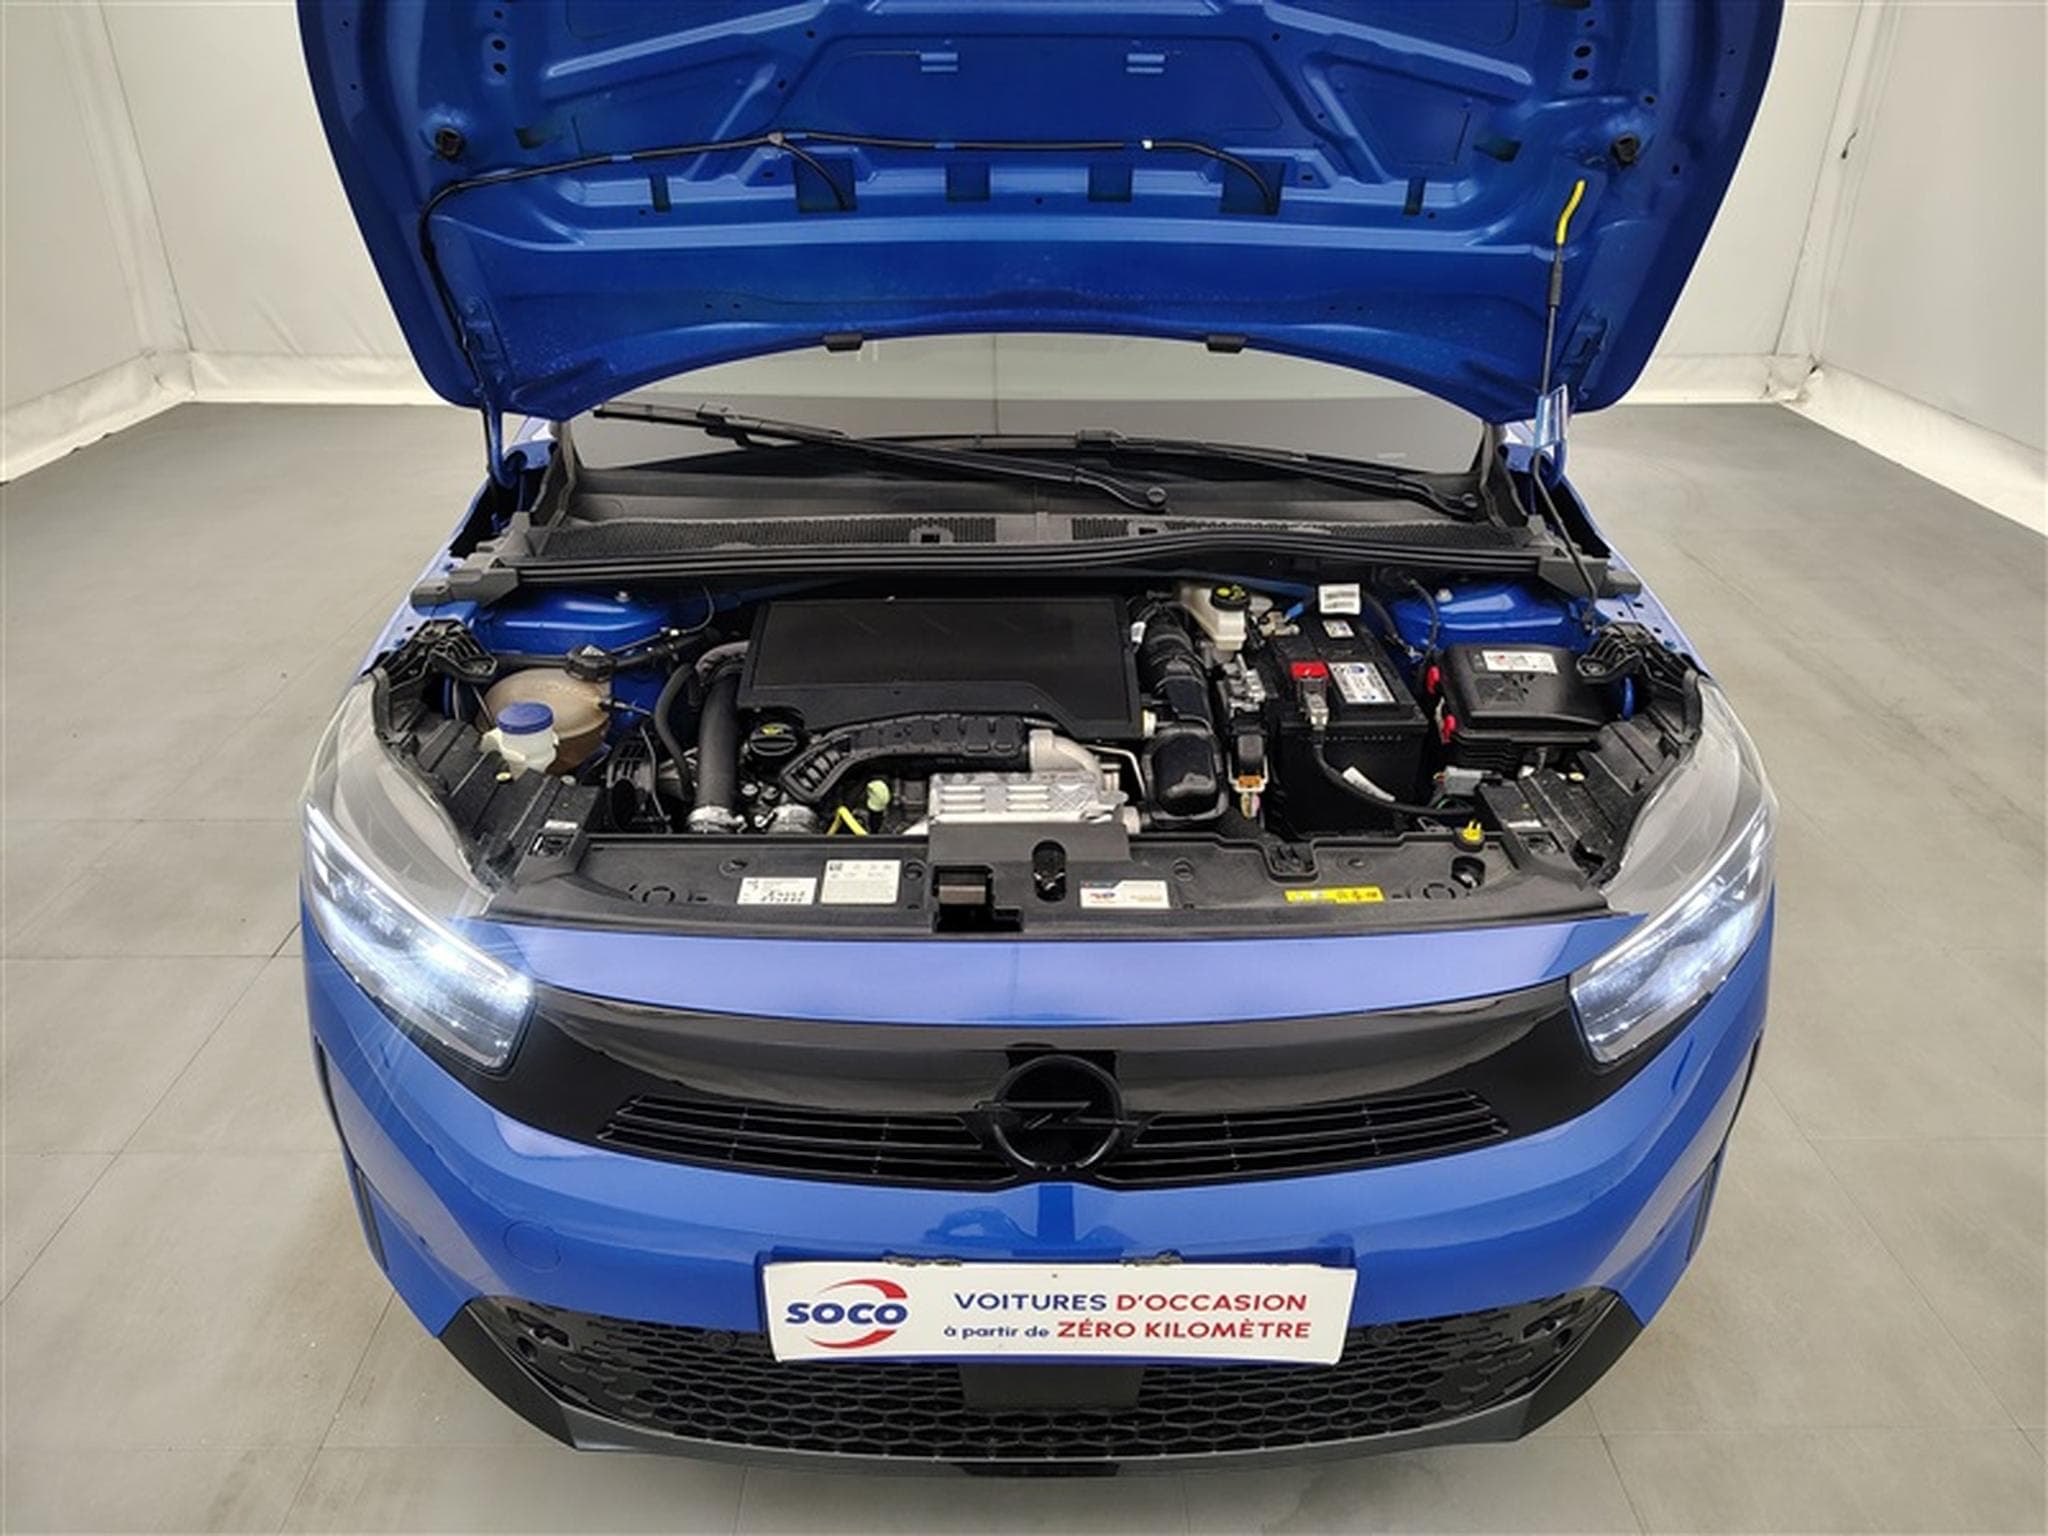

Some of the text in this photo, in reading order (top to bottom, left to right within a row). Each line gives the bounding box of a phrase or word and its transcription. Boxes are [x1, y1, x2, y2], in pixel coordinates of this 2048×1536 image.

[784, 1302, 908, 1325] SOCO
[953, 1293, 1307, 1312] VOITURES D'OCCASION
[943, 1317, 1312, 1340] à partir de ZÉRO KILOMÈTRE
